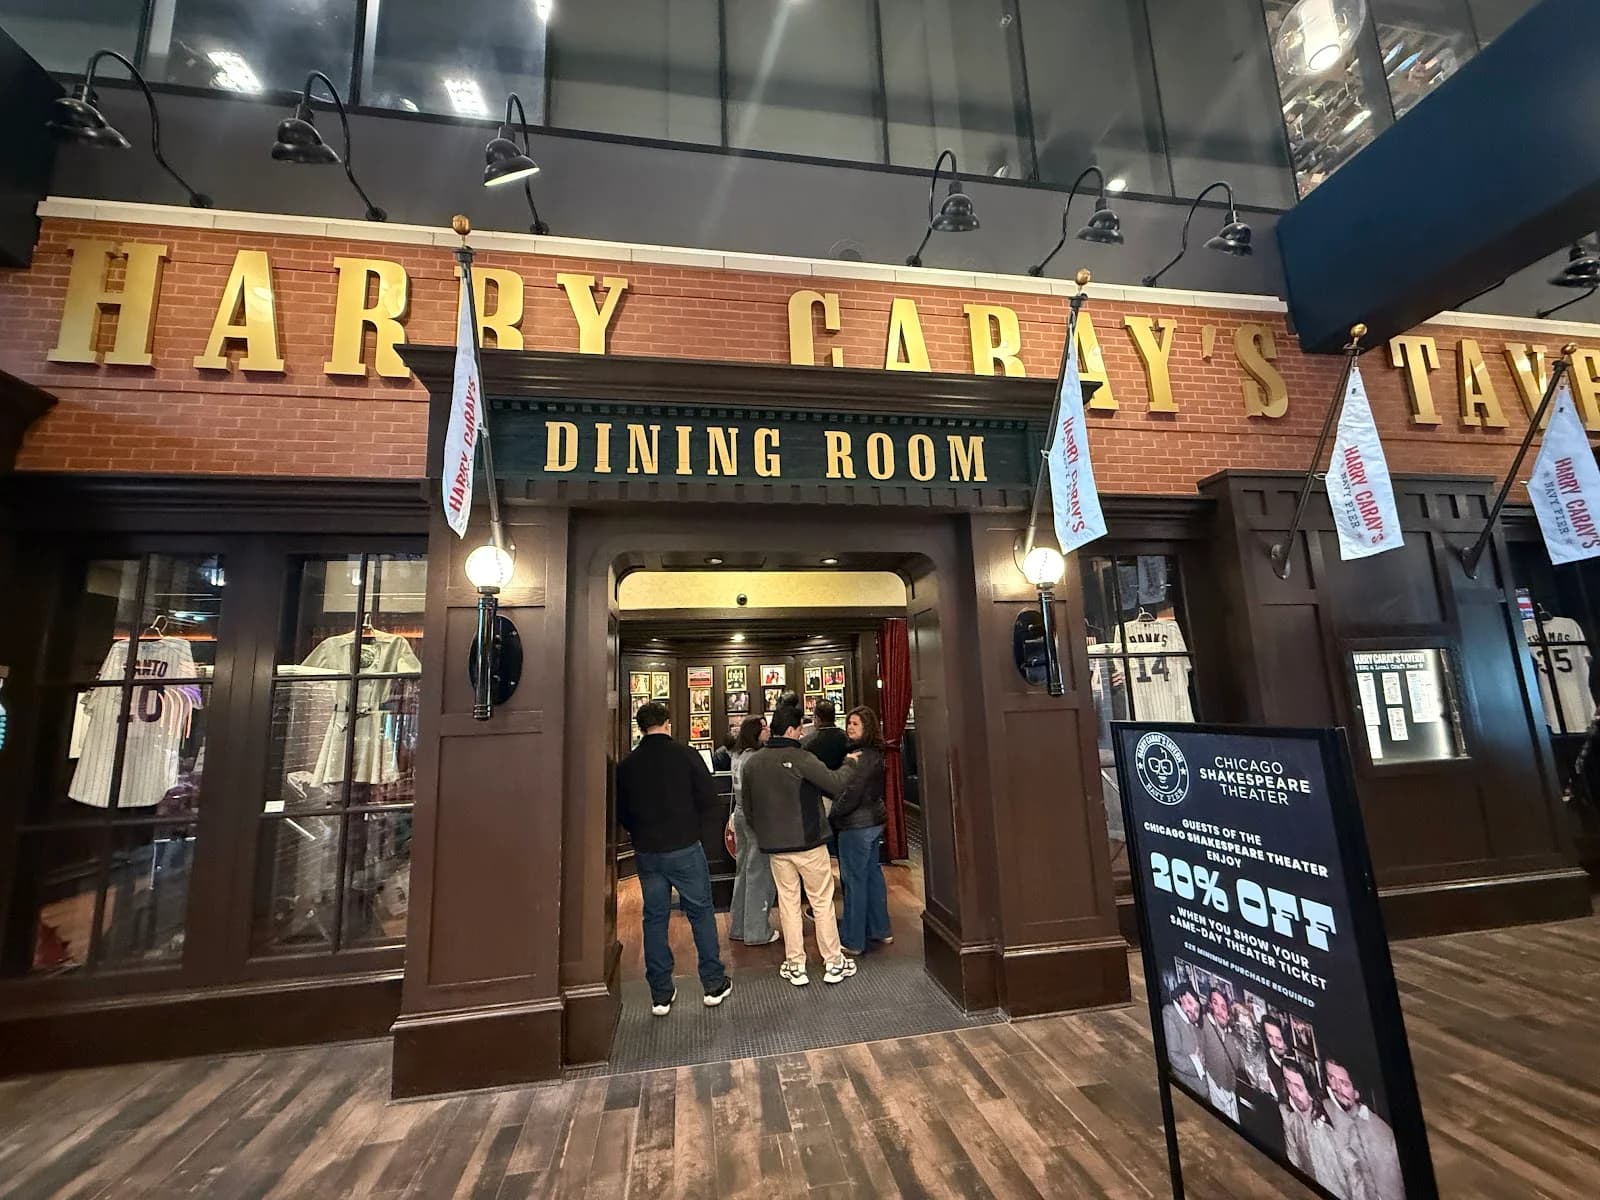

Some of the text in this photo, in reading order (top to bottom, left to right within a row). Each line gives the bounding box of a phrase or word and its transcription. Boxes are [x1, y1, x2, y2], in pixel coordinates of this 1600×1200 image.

[47, 239, 629, 379] HARRY
[787, 290, 1289, 419] CARAY'S
[463, 375, 477, 448] CARAY'S
[543, 421, 988, 482] DINING ROOM
[1062, 416, 1079, 465] HARRY
[1071, 470, 1085, 533] CARAY'S
[1344, 445, 1384, 544] HARRY CARAY'S
[1345, 501, 1360, 529] PIER
[1554, 457, 1600, 549] HARRY CARAY'S
[1554, 508, 1569, 535] PIER
[1129, 633, 1168, 647] BANKS
[1137, 656, 1169, 683] 14
[1199, 767, 1312, 794] SHAKESPEARE
[1214, 756, 1283, 775] CHICAGO
[1220, 783, 1289, 806] THEATER
[1143, 821, 1329, 878] CHICAGO SHAKESPEARE THEATER
[1182, 818, 1262, 846] GUESTS OF THE
[1206, 850, 1242, 869] ENJOY
[1150, 851, 1337, 952] 20% OFF
[1169, 914, 1327, 991] SAME-DAY THEATER TICKET
[1177, 905, 1310, 970] WHEN YOU SHOW YOUR
[1197, 948, 1230, 969] MINIMUM
[1230, 963, 1271, 987] PURCHASE
[1271, 980, 1315, 1008] REQUIRED
